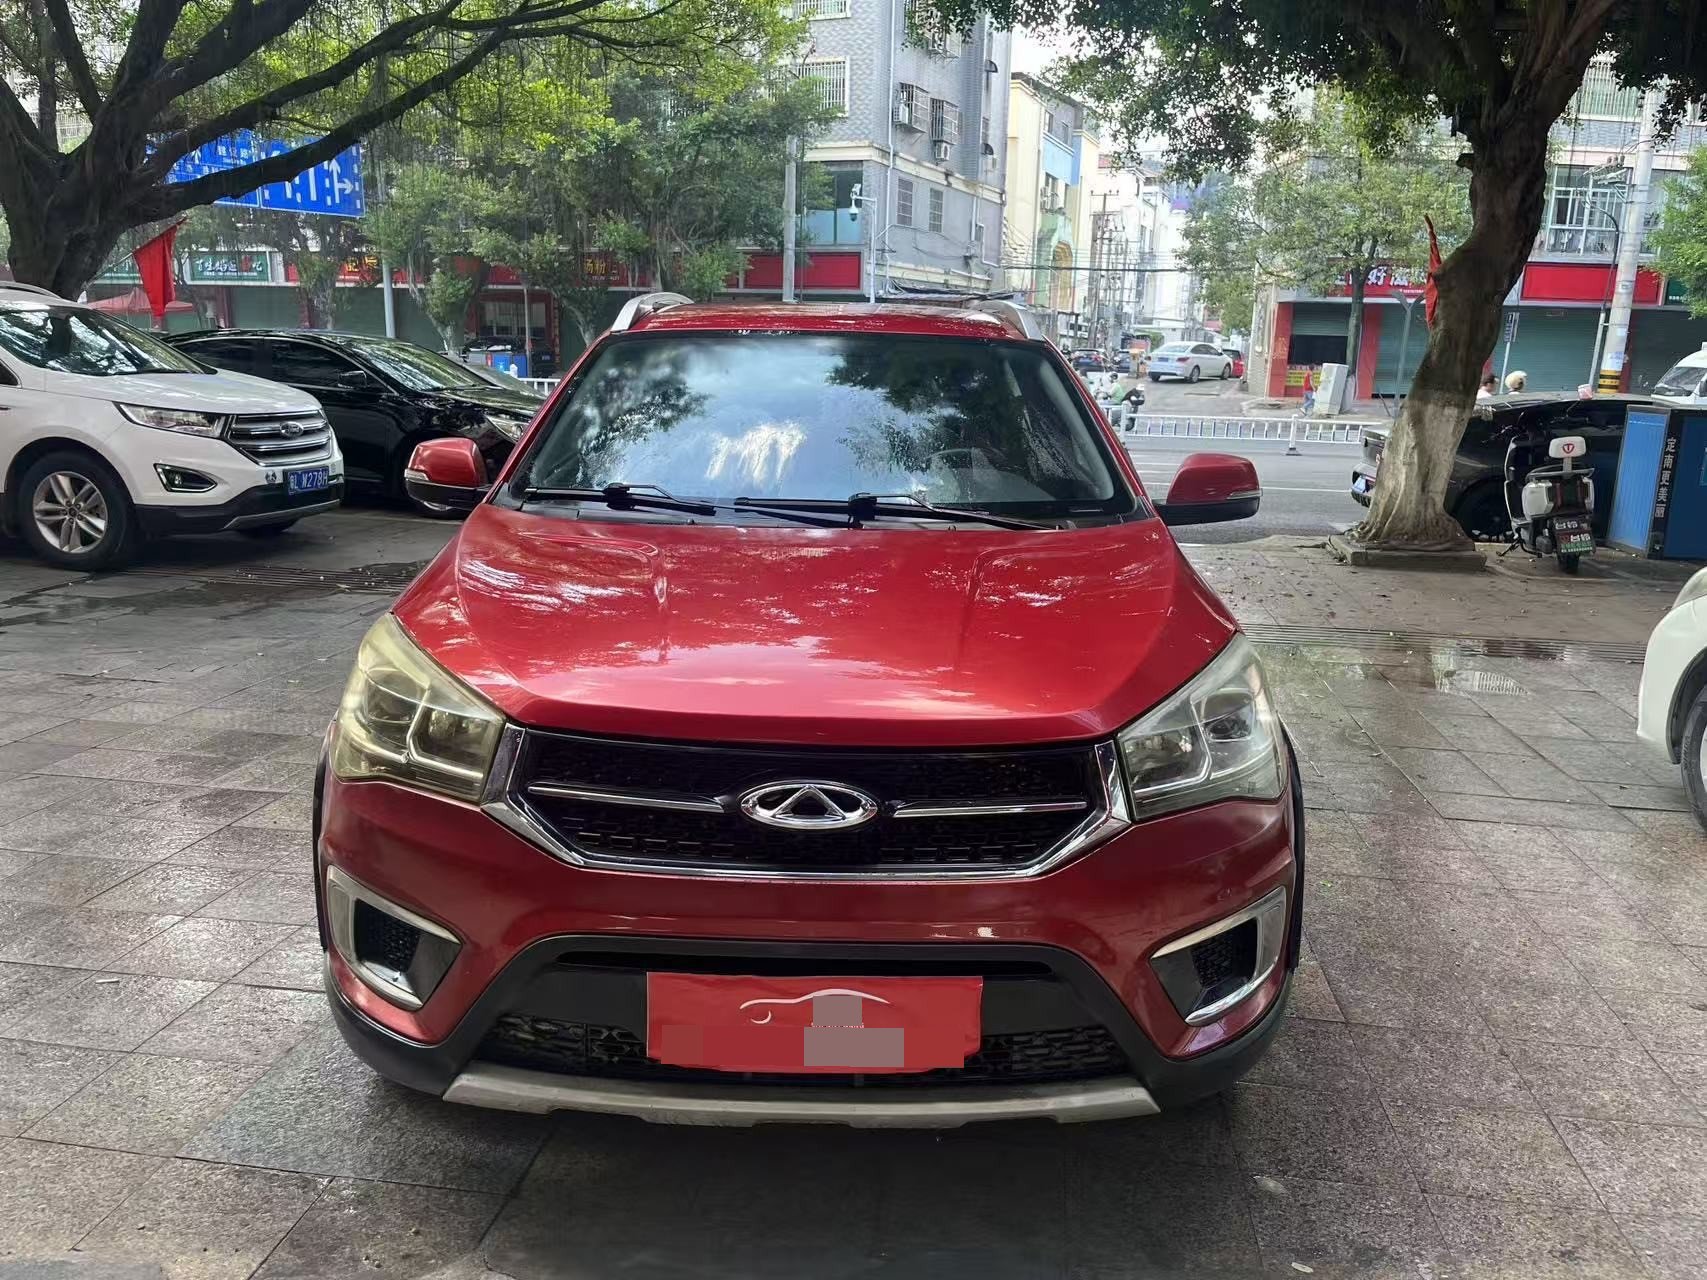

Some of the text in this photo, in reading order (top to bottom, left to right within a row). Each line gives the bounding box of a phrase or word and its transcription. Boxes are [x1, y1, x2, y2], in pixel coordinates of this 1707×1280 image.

[1655, 437, 1677, 518] 定南更美丽
